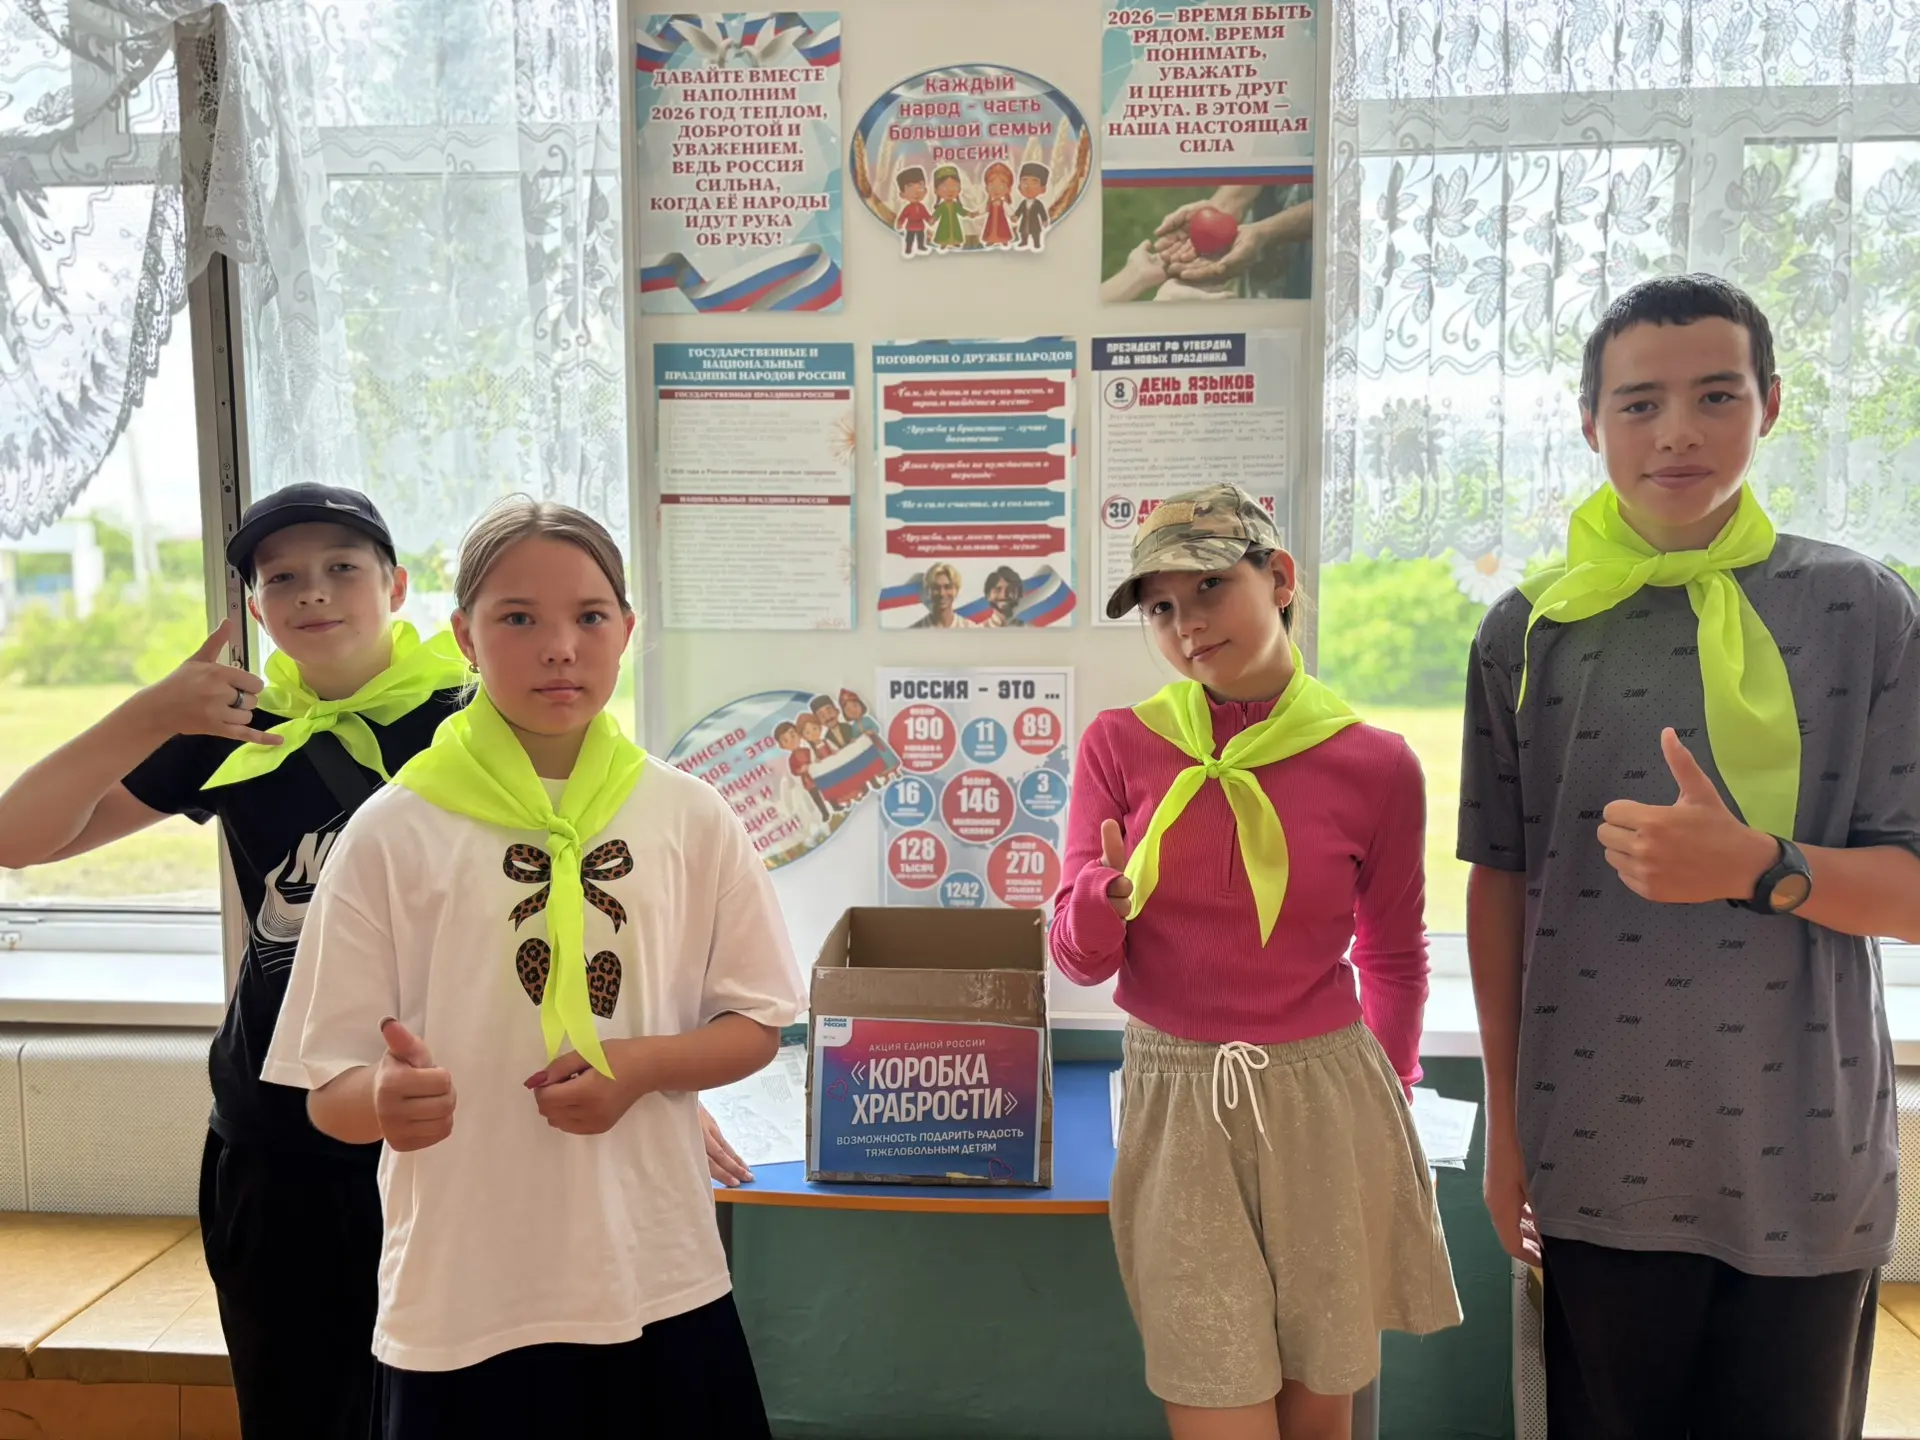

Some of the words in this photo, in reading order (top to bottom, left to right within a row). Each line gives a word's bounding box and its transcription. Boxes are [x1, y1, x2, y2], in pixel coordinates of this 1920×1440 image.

[1108, 11, 1153, 25] 2026
[1178, 7, 1246, 23] ВРЕМЯ
[1252, 5, 1311, 20] БЫТЬ
[1133, 28, 1210, 45] РЯДОМ.
[1215, 25, 1285, 41] ВРЕМЯ
[1146, 46, 1267, 62] ПОНИМАТЬ,
[654, 67, 744, 86] ДАВАЙТЕ
[749, 68, 825, 83] ВМЕСТЕ
[1159, 64, 1257, 81] УВАЖАТЬ
[683, 87, 796, 102] НАПОЛНИМ
[1129, 86, 1144, 99] И
[1148, 84, 1232, 101] ЦЕНИТЬ
[1236, 81, 1288, 99] ДРУГ
[652, 107, 695, 120] 2026
[699, 107, 735, 121] ГОД
[740, 105, 828, 120] ТЕПЛОМ,
[900, 102, 961, 118] народ
[984, 99, 1040, 113] часть
[1123, 103, 1190, 120] ДРУГА.
[1195, 103, 1208, 116] В
[1213, 101, 1269, 115] ЭТОМ
[678, 122, 783, 140] ДОБРОТОЙ
[788, 124, 801, 136] И
[889, 122, 980, 140] большой
[988, 122, 1051, 135] семьи
[1108, 122, 1171, 136] НАША
[1175, 118, 1308, 135] НАСТОЯЩАЯ
[672, 142, 804, 158] УВАЖЕНИЕМ.
[1179, 139, 1235, 153] СИЛА
[672, 161, 721, 175] ВЕДЬ
[726, 159, 804, 173] РОССИЯ
[695, 178, 781, 193] СИЛЬНА,
[650, 197, 711, 212] КОГДА
[716, 193, 738, 210] ЕЁ
[742, 195, 828, 210] НАРОДЫ
[685, 215, 737, 230] ИДУТ
[742, 214, 792, 228] РУКА
[696, 233, 721, 246] ОБ
[726, 232, 782, 246] РУКУ!
[688, 347, 808, 359] ГОСУДАРСТВЕННЫЕ
[810, 348, 818, 357] И
[1107, 342, 1161, 353] ПРЕЗИДЕНТ
[1165, 341, 1180, 351] РФ
[1183, 339, 1232, 351] УТВЕРДИЛ
[703, 359, 805, 370] НАЦИОНАЛЬНЫЕ
[877, 354, 949, 365] ПОГОВОРКИ
[951, 354, 960, 363] О
[962, 353, 1013, 364] ДРУЖБЕ
[1016, 351, 1073, 362] НАРОДОВ
[1111, 355, 1131, 366] ДВА
[1134, 354, 1168, 364] НОВЫХ
[1171, 352, 1228, 364] ПРАЗДНИКА
[665, 371, 737, 382] ПРАЗДНИКИ
[739, 371, 796, 382] НАРОДОВ
[797, 371, 846, 380] РОССИИ
[1139, 377, 1181, 392] ДЕНЬ
[1188, 374, 1255, 390] ЯЗЫКОВ
[1115, 382, 1125, 398] 8
[1139, 392, 1198, 406] НАРОДОВ
[1204, 391, 1254, 405] РОССИИ
[1109, 502, 1131, 518] 30
[1773, 570, 1801, 580] NIKE
[890, 680, 969, 700] РОССИЯ
[998, 680, 1035, 700] ЭТО
[904, 716, 944, 741] 190
[975, 720, 994, 742] 11
[1022, 713, 1052, 737] 89
[1575, 731, 1601, 740] NIKE
[1037, 773, 1050, 793] 3
[895, 781, 920, 805] 16
[956, 787, 1000, 813] 146
[897, 837, 936, 861] 128
[1006, 850, 1045, 875] 270
[945, 882, 979, 898] 1242
[1579, 889, 1601, 900] NIKE
[1665, 978, 1692, 988] NIKE
[869, 1042, 901, 1052] АКЦИЯ
[904, 1039, 943, 1050] ЕДИНОЙ
[946, 1038, 986, 1049] РОССИИ
[1574, 1048, 1596, 1059] NIKE
[850, 1053, 989, 1090] «КОРОБКА
[1665, 1058, 1693, 1069] NIKE
[851, 1088, 1018, 1125] ХРАБРОСТИ»
[836, 1132, 917, 1145] ВОЗМОЖНОСТЬ
[919, 1130, 974, 1143] ПОДАРИТЬ
[976, 1128, 1024, 1139] РАДОСТЬ
[1573, 1129, 1598, 1139] NIKE
[865, 1145, 960, 1158] ТЯЖЕЛОБОЛЬНЫМ
[961, 1143, 997, 1154] ДЕТЯМ
[1669, 1138, 1695, 1148] NIKE
[1578, 1206, 1603, 1217] NIKE
[1672, 1214, 1700, 1224] NIKE
[1765, 1231, 1790, 1242] NIKE
